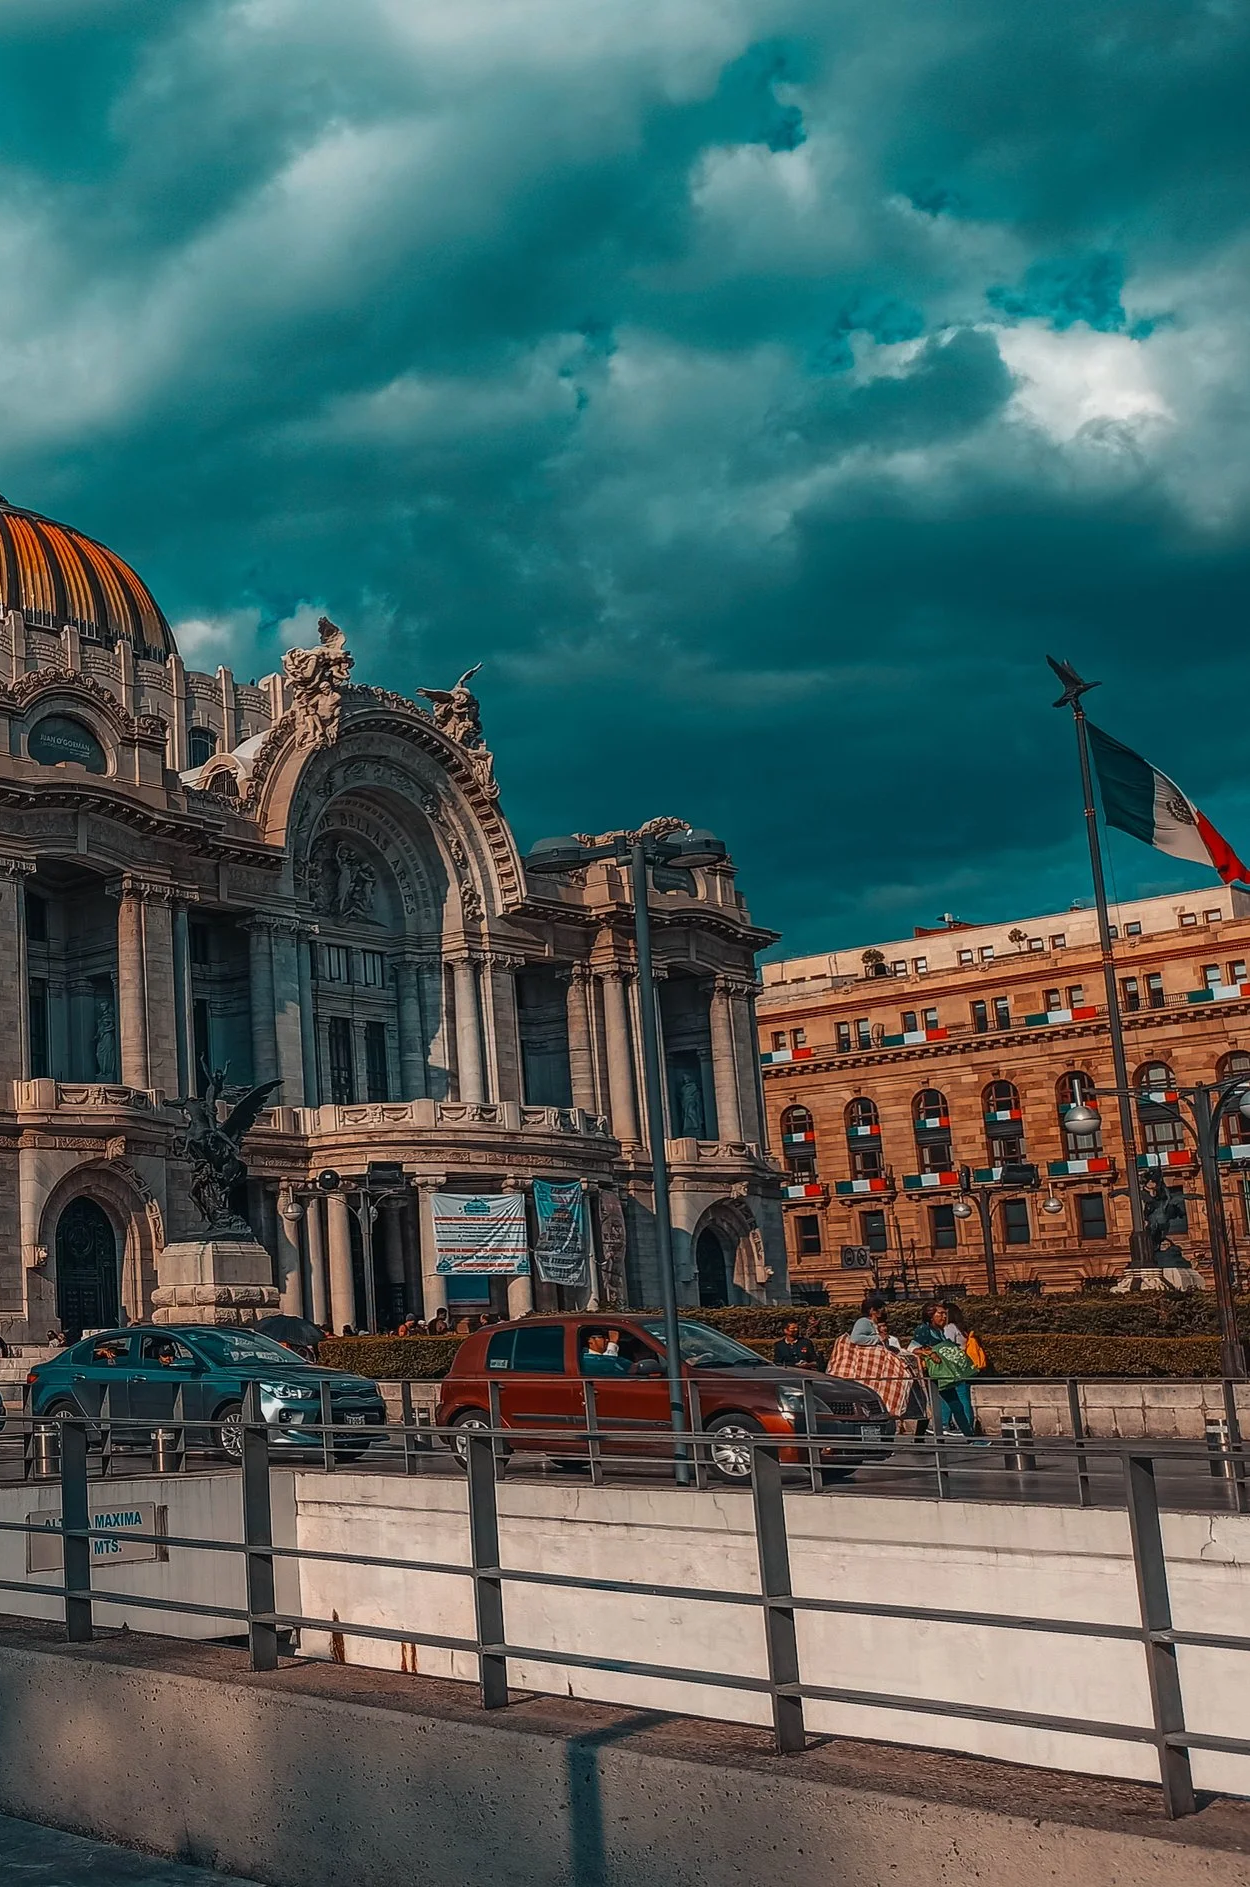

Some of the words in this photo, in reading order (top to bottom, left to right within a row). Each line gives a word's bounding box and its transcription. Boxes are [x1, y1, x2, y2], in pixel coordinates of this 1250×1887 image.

[40, 734, 56, 744] JUAN
[318, 814, 335, 830] DE
[340, 813, 388, 851] BELLAS
[390, 859, 416, 916] ARTES
[94, 1511, 143, 1529] MAXIMA
[94, 1540, 123, 1555] MTS.
